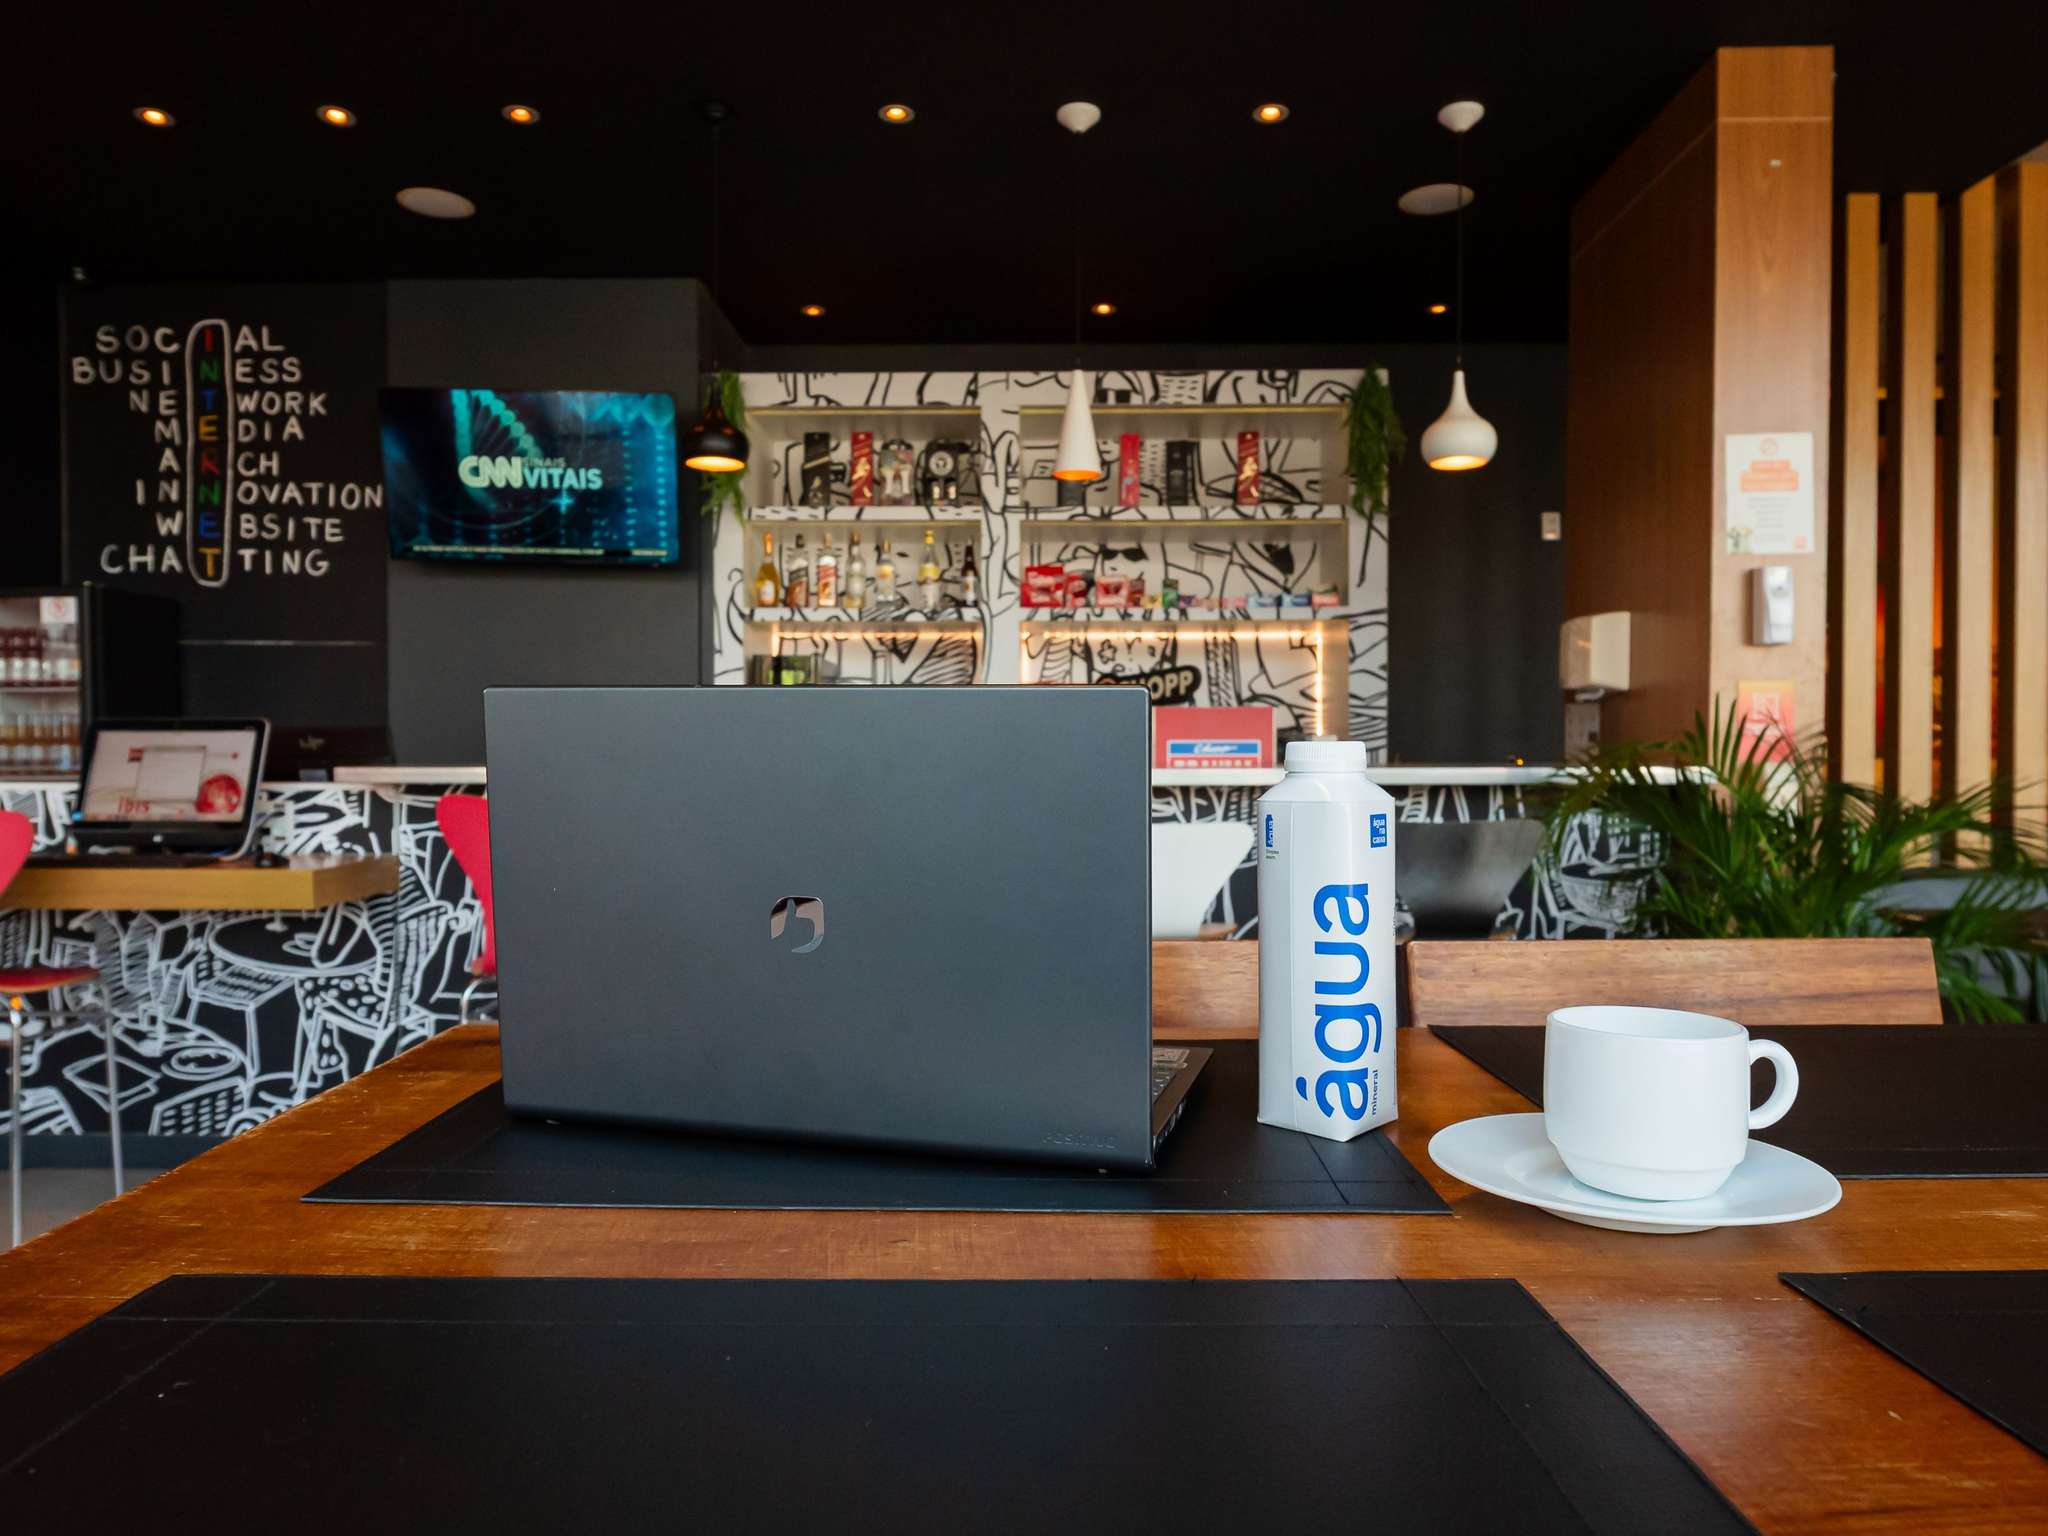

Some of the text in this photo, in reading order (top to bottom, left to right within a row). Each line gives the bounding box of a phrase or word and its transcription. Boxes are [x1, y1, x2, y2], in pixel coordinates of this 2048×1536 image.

[458, 455, 523, 488] CNN
[524, 467, 603, 490] VITAIS
[1295, 883, 1383, 1121] água
